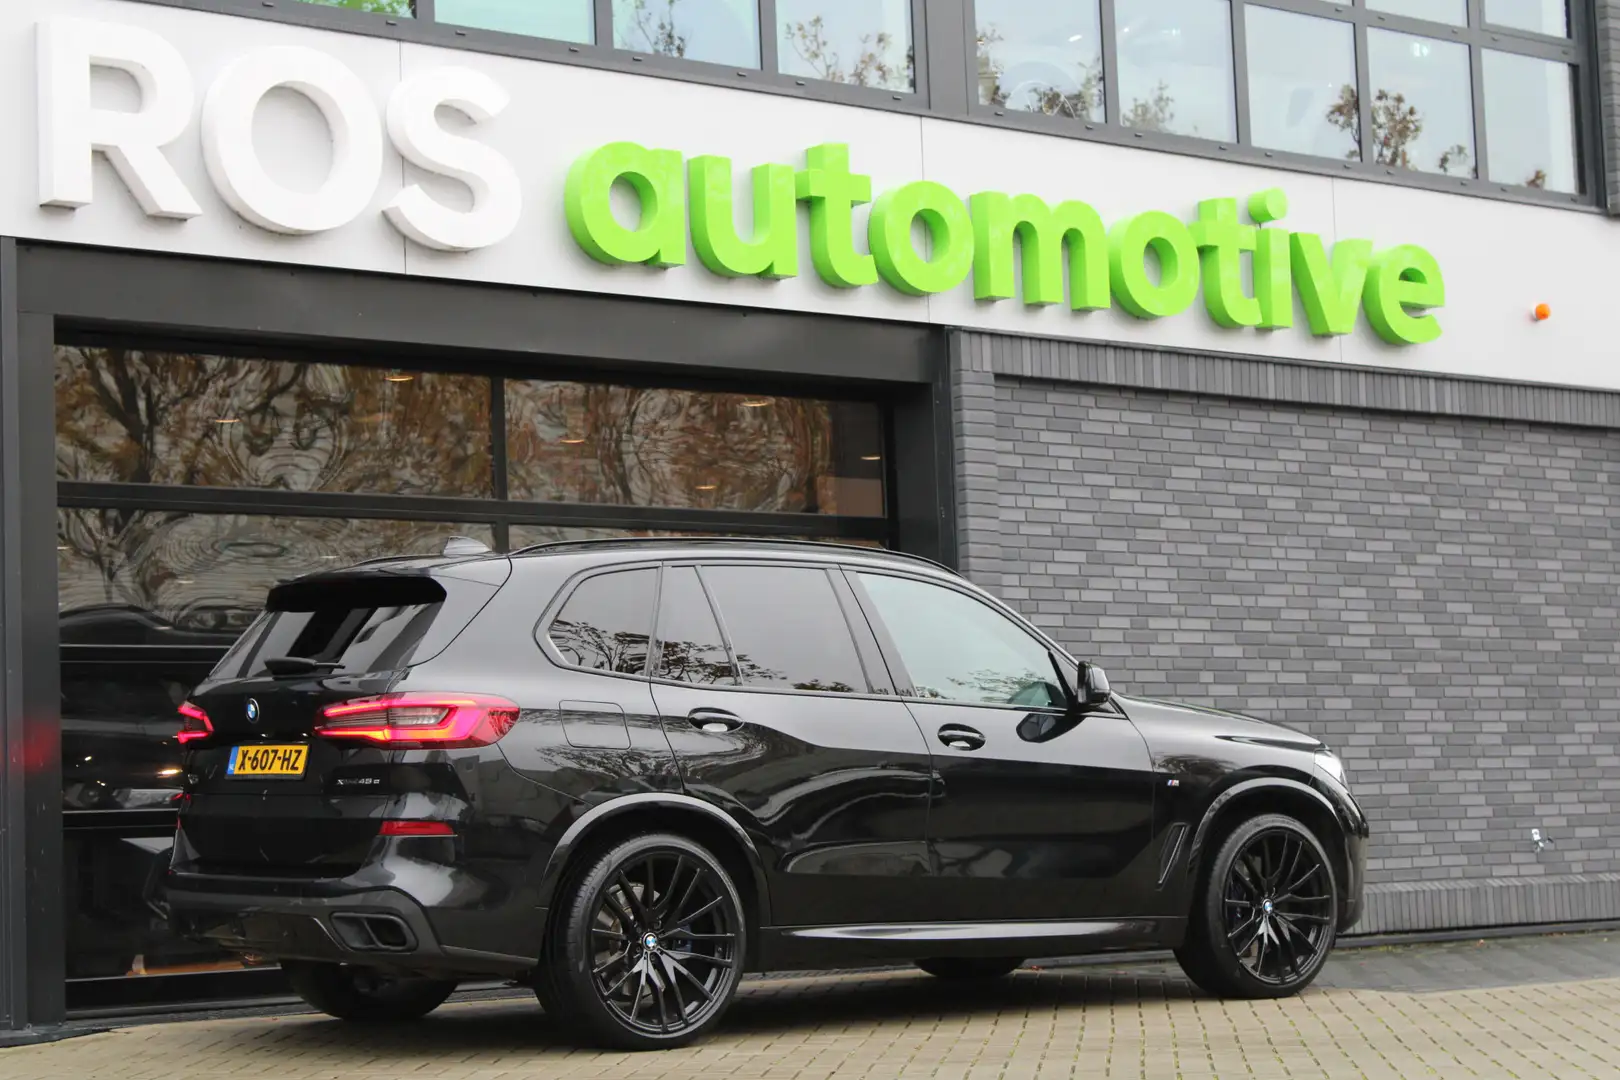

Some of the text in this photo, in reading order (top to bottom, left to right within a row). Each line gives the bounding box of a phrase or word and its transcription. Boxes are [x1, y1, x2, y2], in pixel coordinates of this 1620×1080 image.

[35, 18, 1445, 344] ROS automotive
[238, 749, 303, 771] X-607-HZ
